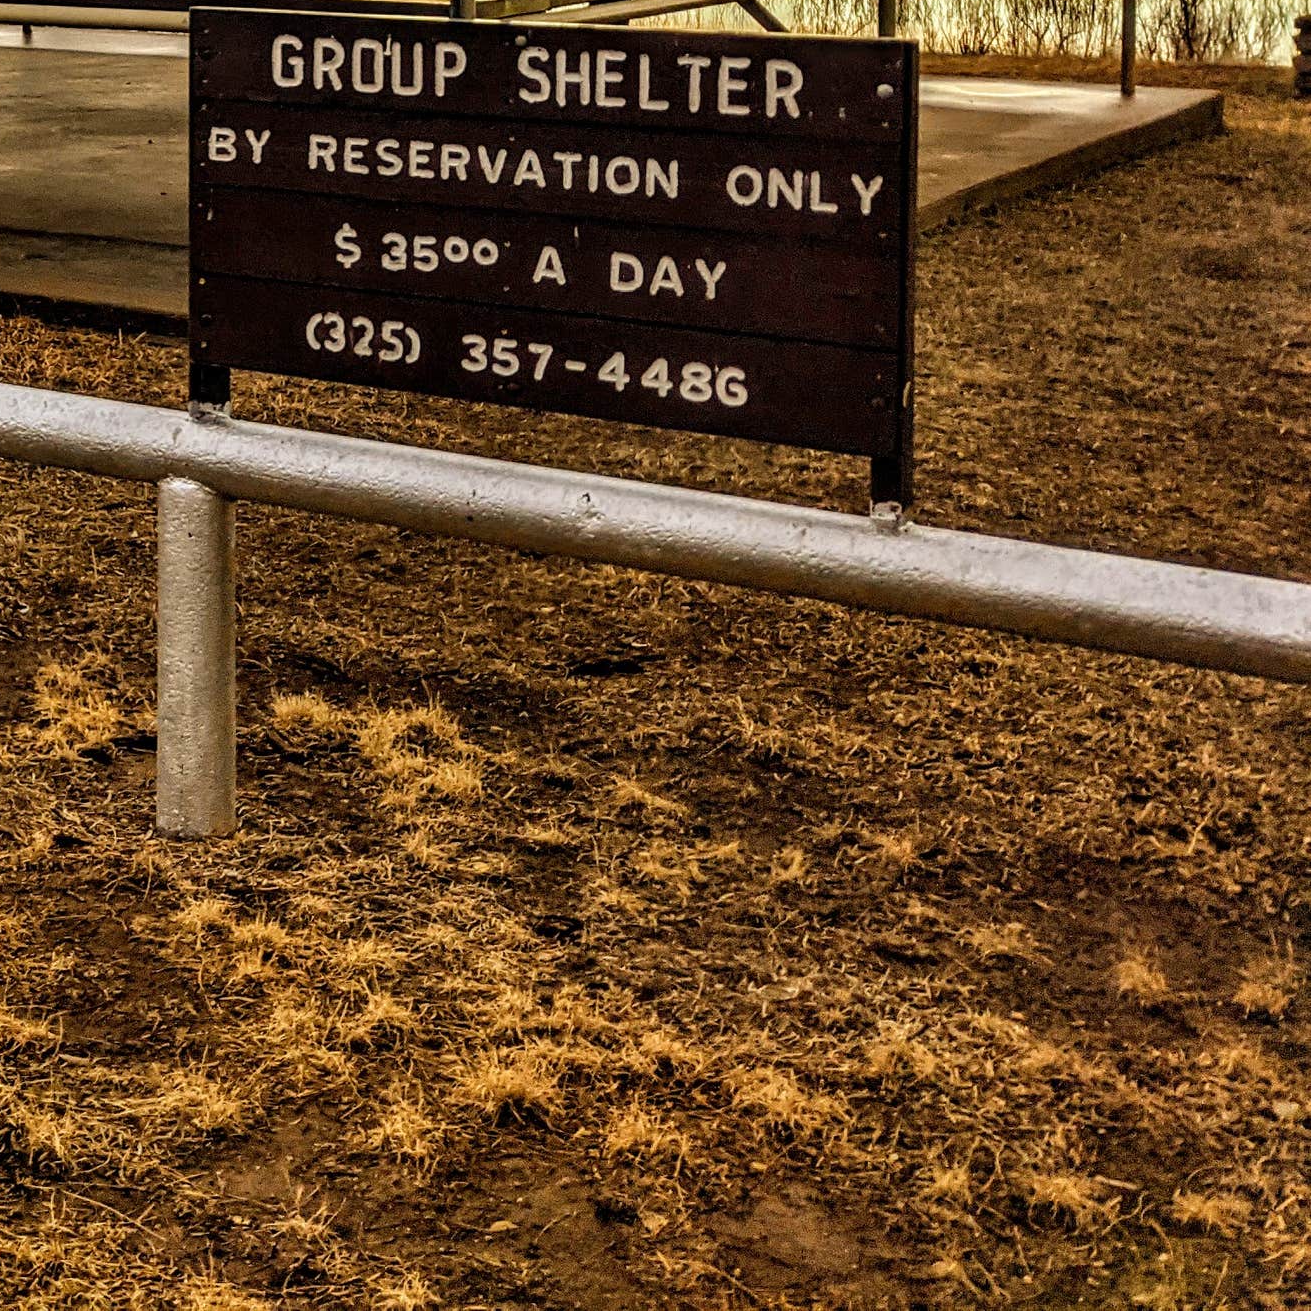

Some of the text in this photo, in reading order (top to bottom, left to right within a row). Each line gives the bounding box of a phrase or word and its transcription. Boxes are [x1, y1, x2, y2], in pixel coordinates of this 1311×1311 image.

[271, 33, 804, 119] GROUP SHELTER
[208, 126, 884, 216] BY RESERVATION ONLY
[532, 246, 567, 286] A
[609, 251, 727, 300] DAY
[305, 311, 421, 364] (325)
